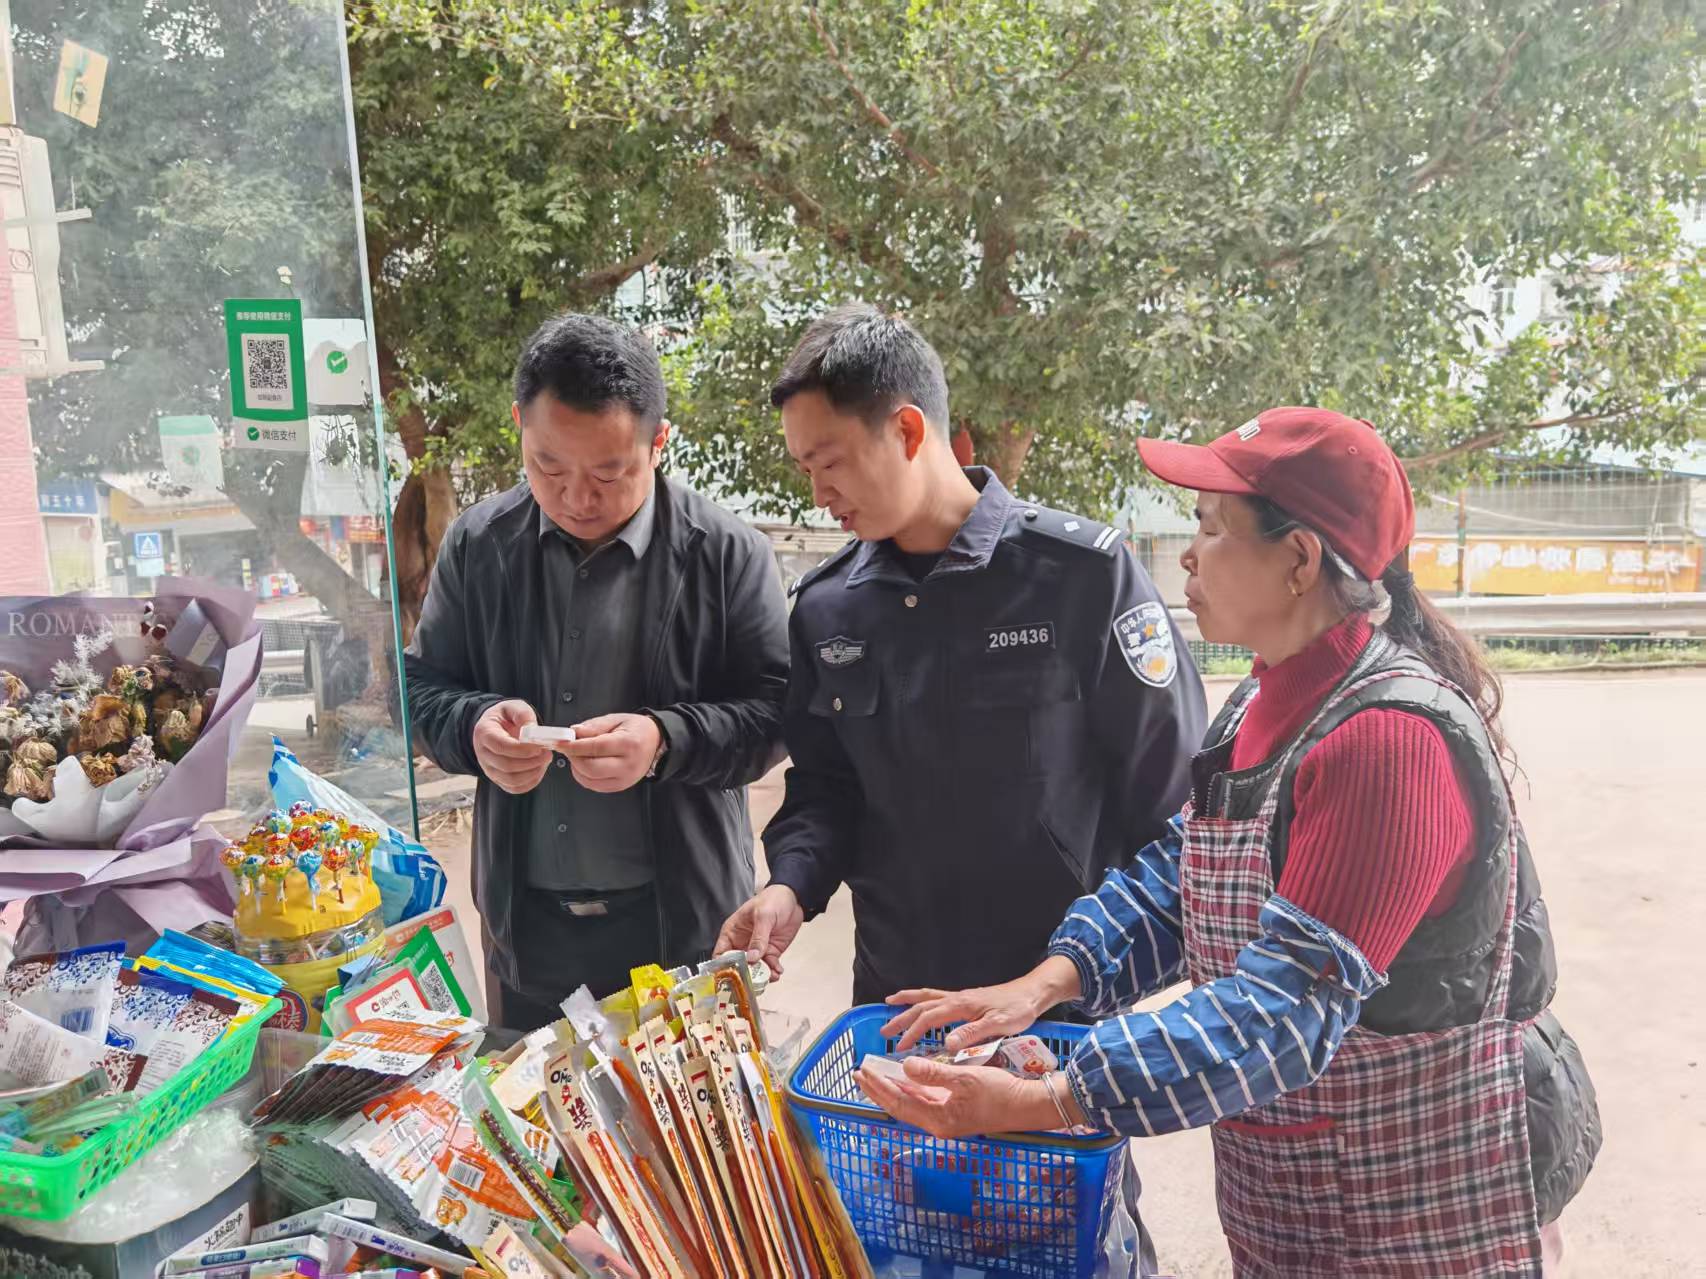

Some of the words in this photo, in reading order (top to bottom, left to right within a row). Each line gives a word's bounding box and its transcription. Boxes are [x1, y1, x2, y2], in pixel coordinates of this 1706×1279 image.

[262, 430, 297, 441] 微信支付
[989, 627, 1049, 649] 209436
